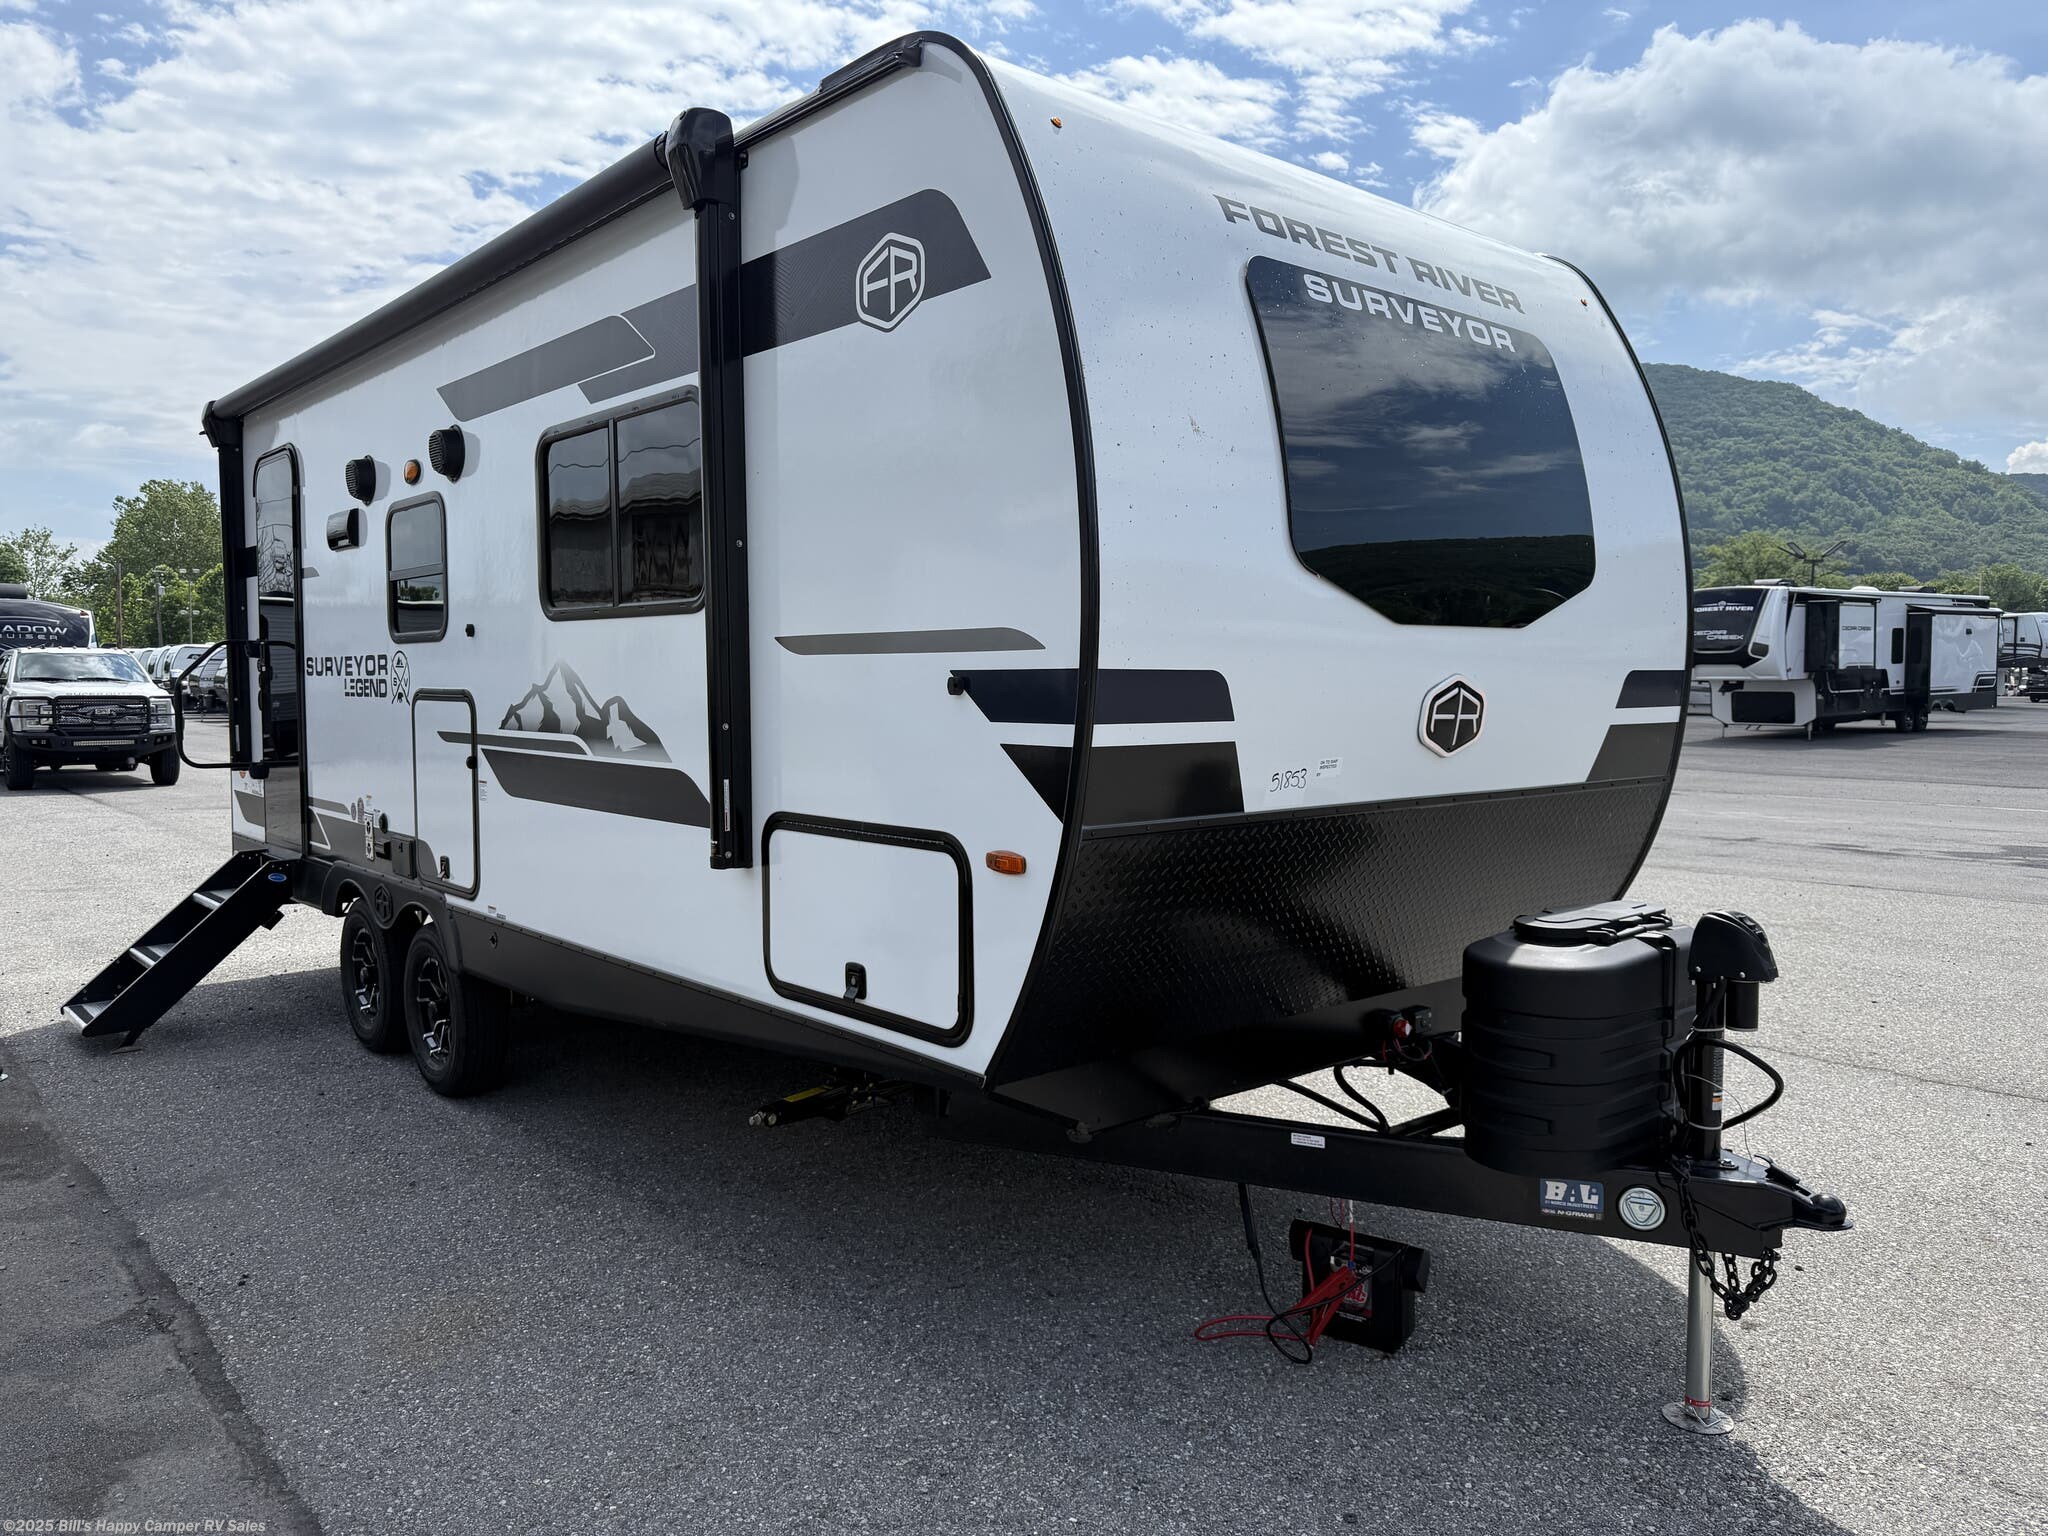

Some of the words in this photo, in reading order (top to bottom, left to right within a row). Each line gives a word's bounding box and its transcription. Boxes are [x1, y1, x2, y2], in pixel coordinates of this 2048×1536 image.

[1212, 194, 1399, 275] FOREST
[1405, 256, 1526, 314] RIVER
[1303, 273, 1516, 353] SURVEYOR
[305, 654, 389, 677] SURVEYOR
[343, 678, 388, 698] LEGEND
[1269, 768, 1308, 793] 51853
[1545, 1181, 1599, 1205] BAL
